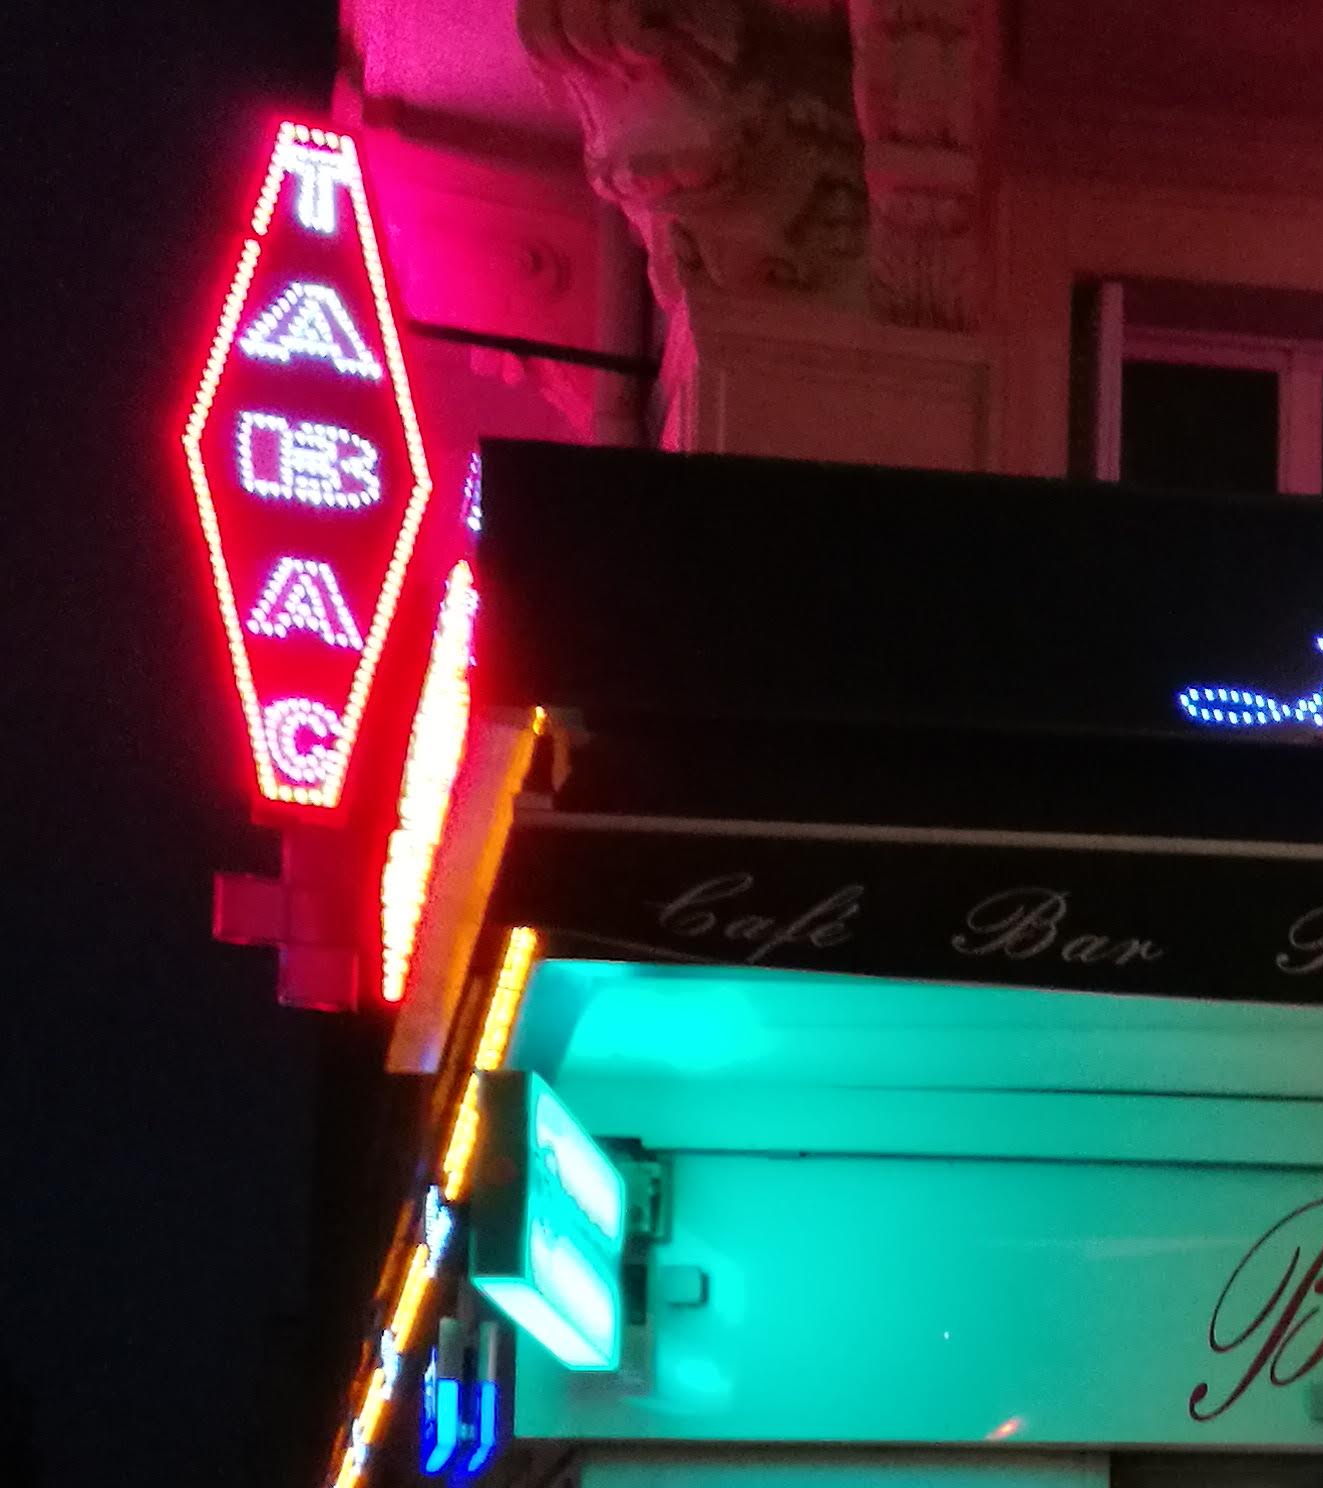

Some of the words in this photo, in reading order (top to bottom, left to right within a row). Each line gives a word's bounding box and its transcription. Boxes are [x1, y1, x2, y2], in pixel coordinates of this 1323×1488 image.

[238, 143, 382, 784] TABAC
[650, 872, 864, 963] Café
[950, 886, 1162, 968] Bar
